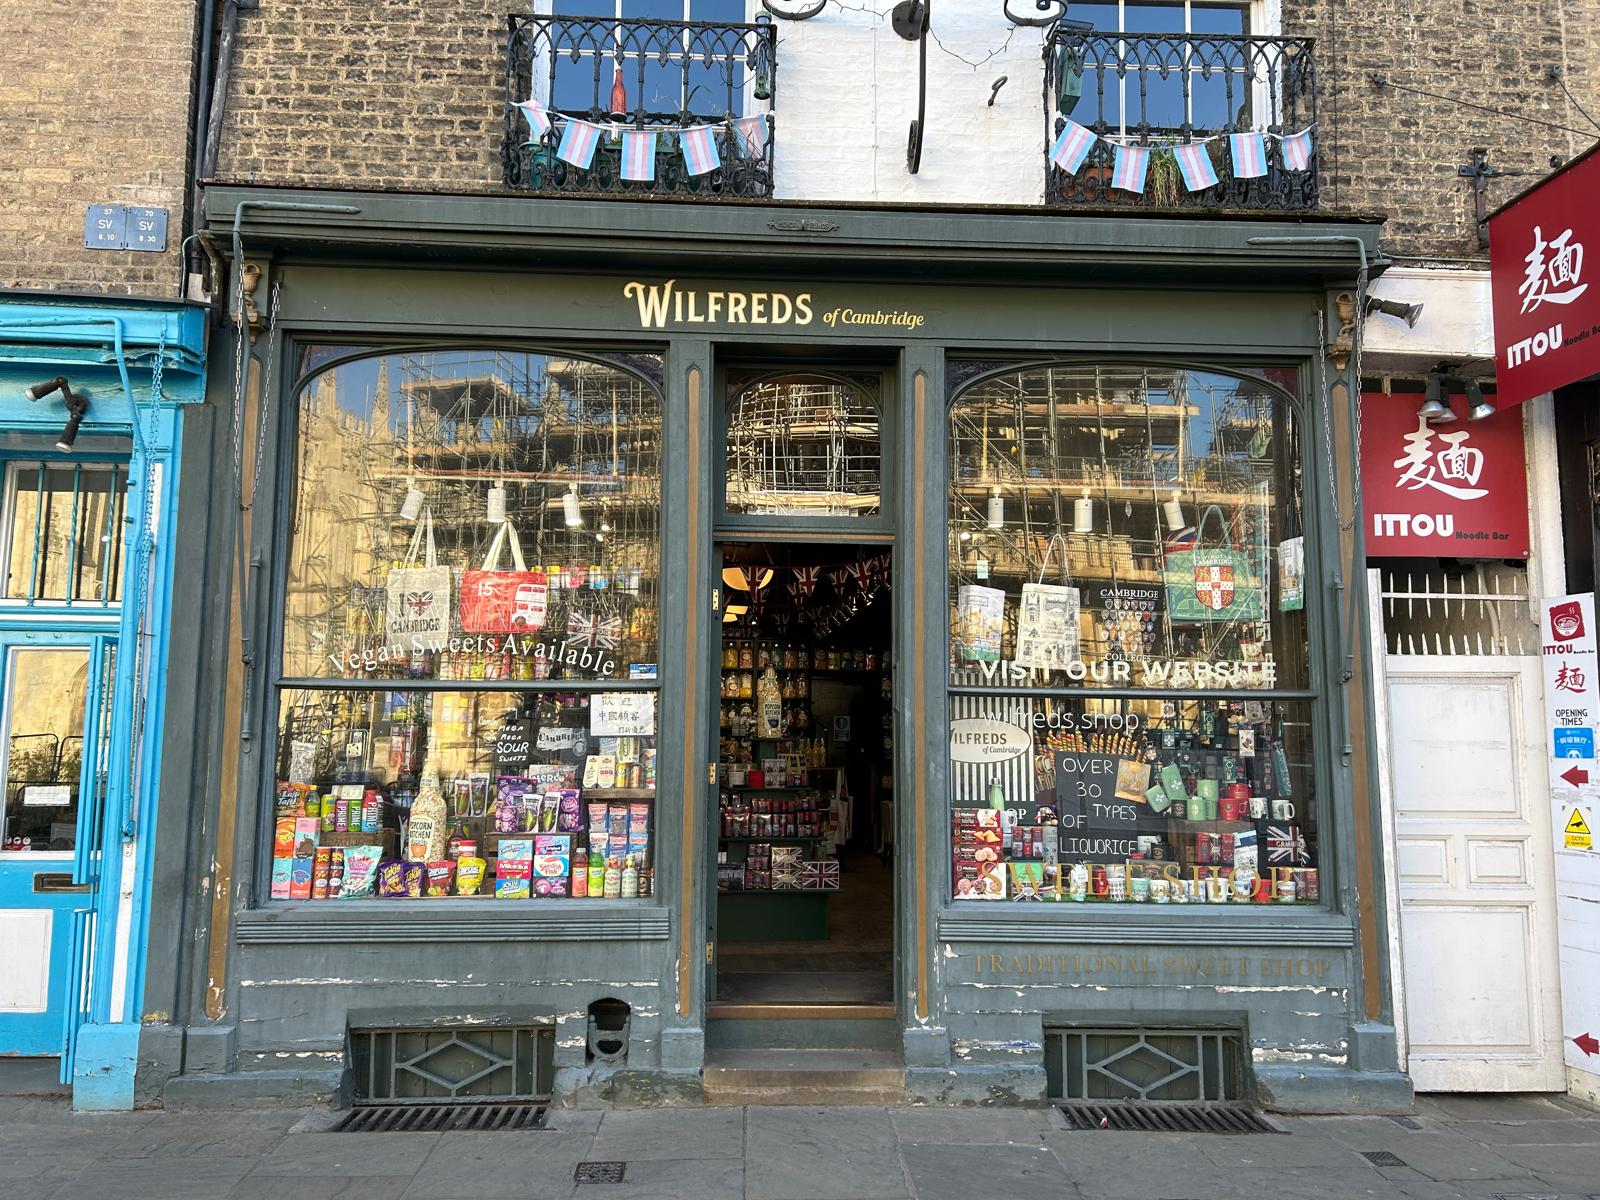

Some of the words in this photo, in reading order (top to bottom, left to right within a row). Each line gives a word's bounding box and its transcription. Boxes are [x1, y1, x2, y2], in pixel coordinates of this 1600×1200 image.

[98, 219, 113, 229] SV
[139, 221, 154, 231] SV
[623, 279, 814, 328] WILFREDS
[823, 309, 839, 327] of
[841, 309, 925, 330] Cambridge
[1507, 323, 1562, 370] ITTOU
[1563, 330, 1590, 348] Noodle
[1592, 326, 1600, 336] Ba
[1373, 513, 1454, 537] ITTOU
[1455, 531, 1489, 540] Noodle
[1492, 531, 1510, 541] Bar
[1100, 588, 1158, 599] CAMBRIDGE
[398, 592, 405, 618] I
[391, 618, 441, 634] CAMBRIDGE
[327, 642, 406, 675] Vegan
[411, 634, 495, 658] Sweets
[501, 633, 615, 676] Available
[1104, 653, 1152, 663] COLLEGES
[1542, 644, 1573, 655] ITTOU
[979, 660, 1053, 680] VISIT
[1066, 660, 1131, 681] OUR
[1141, 661, 1277, 684] WEBSITE
[982, 707, 1139, 733] wilfreds.shop
[1555, 708, 1588, 718] OPENING
[1561, 717, 1583, 726] TIMES
[951, 728, 1007, 745] ILFREDS
[496, 741, 529, 754] SOUR
[990, 745, 1022, 755] Cambridge
[1062, 757, 1114, 775] OVER
[1076, 781, 1102, 798] 30
[337, 806, 347, 829] PRIME
[351, 806, 361, 829] PRIME
[366, 801, 377, 829] PRIME
[1092, 803, 1137, 821] TYPES
[1062, 814, 1088, 829] OF
[1059, 837, 1138, 856] LIQUORICE
[981, 862, 1144, 897] SWEET
[1163, 863, 1292, 899] SHOP
[975, 953, 1158, 976] TRADITIONAL
[1163, 956, 1251, 977] SWEET
[1260, 957, 1329, 978] SHOP
